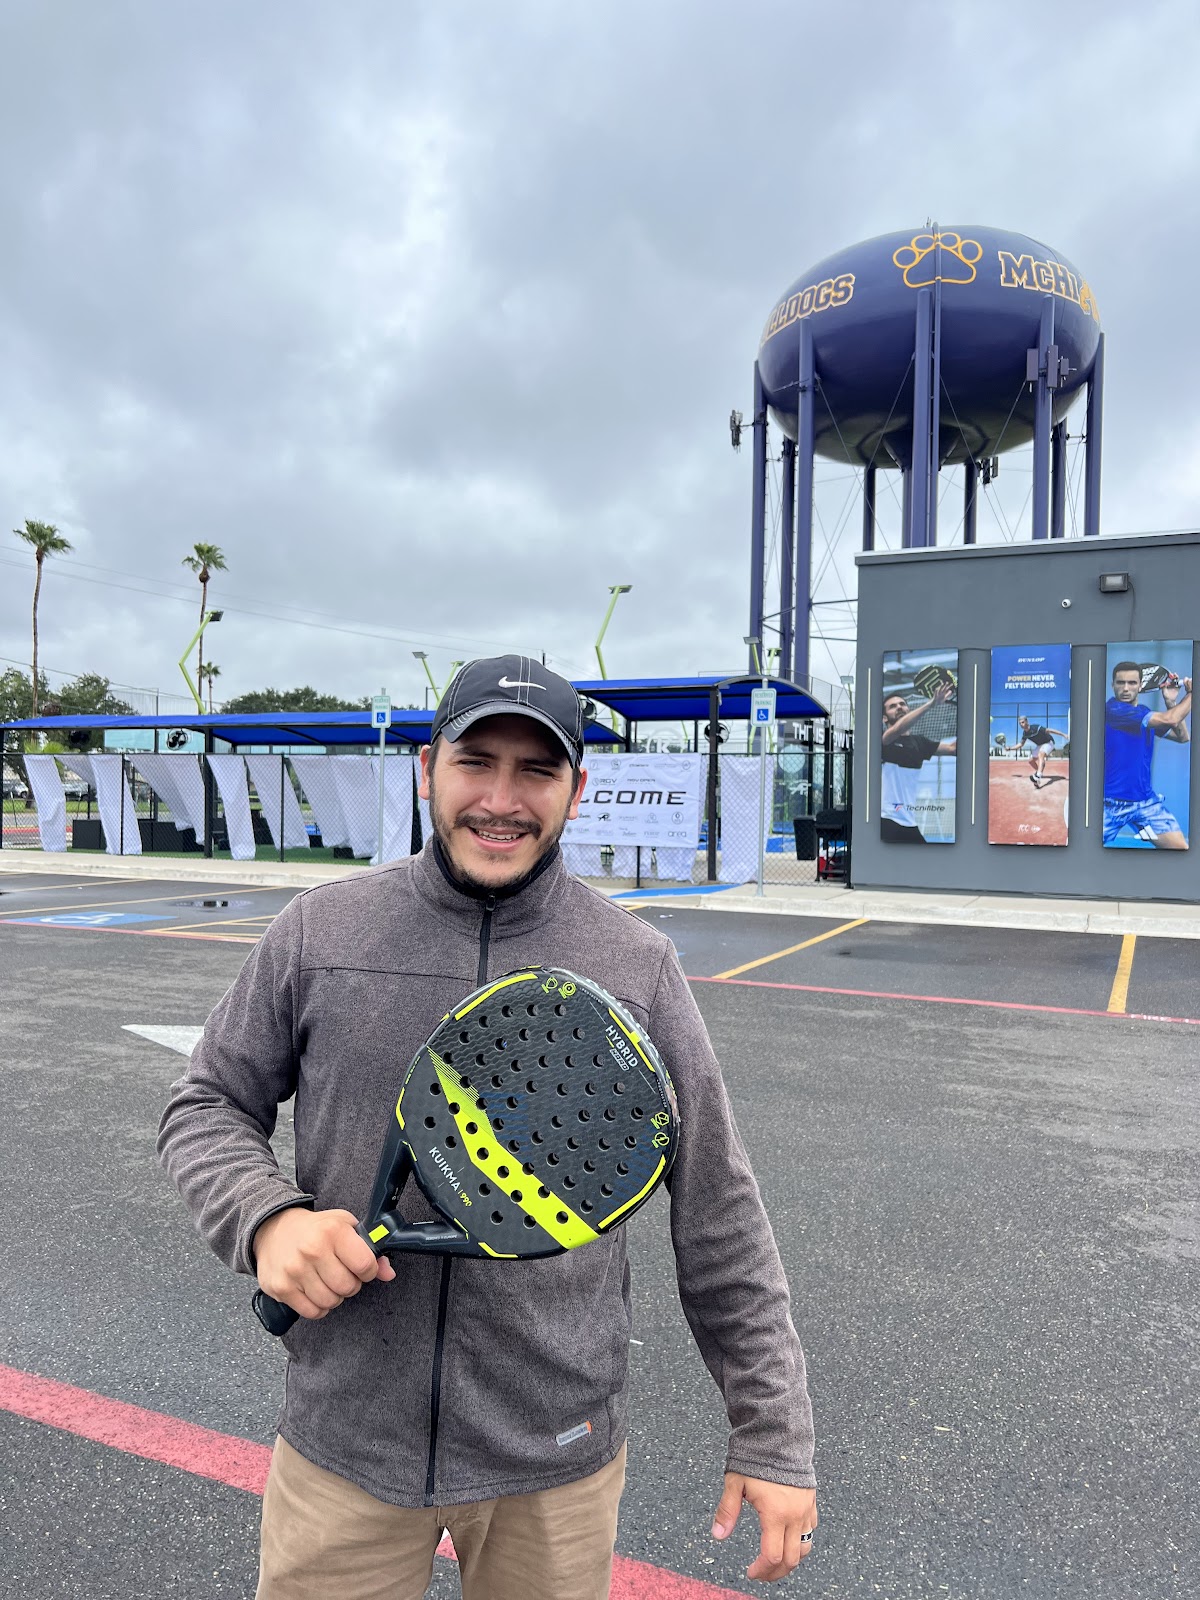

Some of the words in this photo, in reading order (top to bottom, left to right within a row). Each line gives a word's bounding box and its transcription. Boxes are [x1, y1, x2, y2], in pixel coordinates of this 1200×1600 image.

[605, 1024, 638, 1067] HYBRID
[428, 1146, 461, 1192] KUIKMA
[460, 1192, 473, 1207] 990
